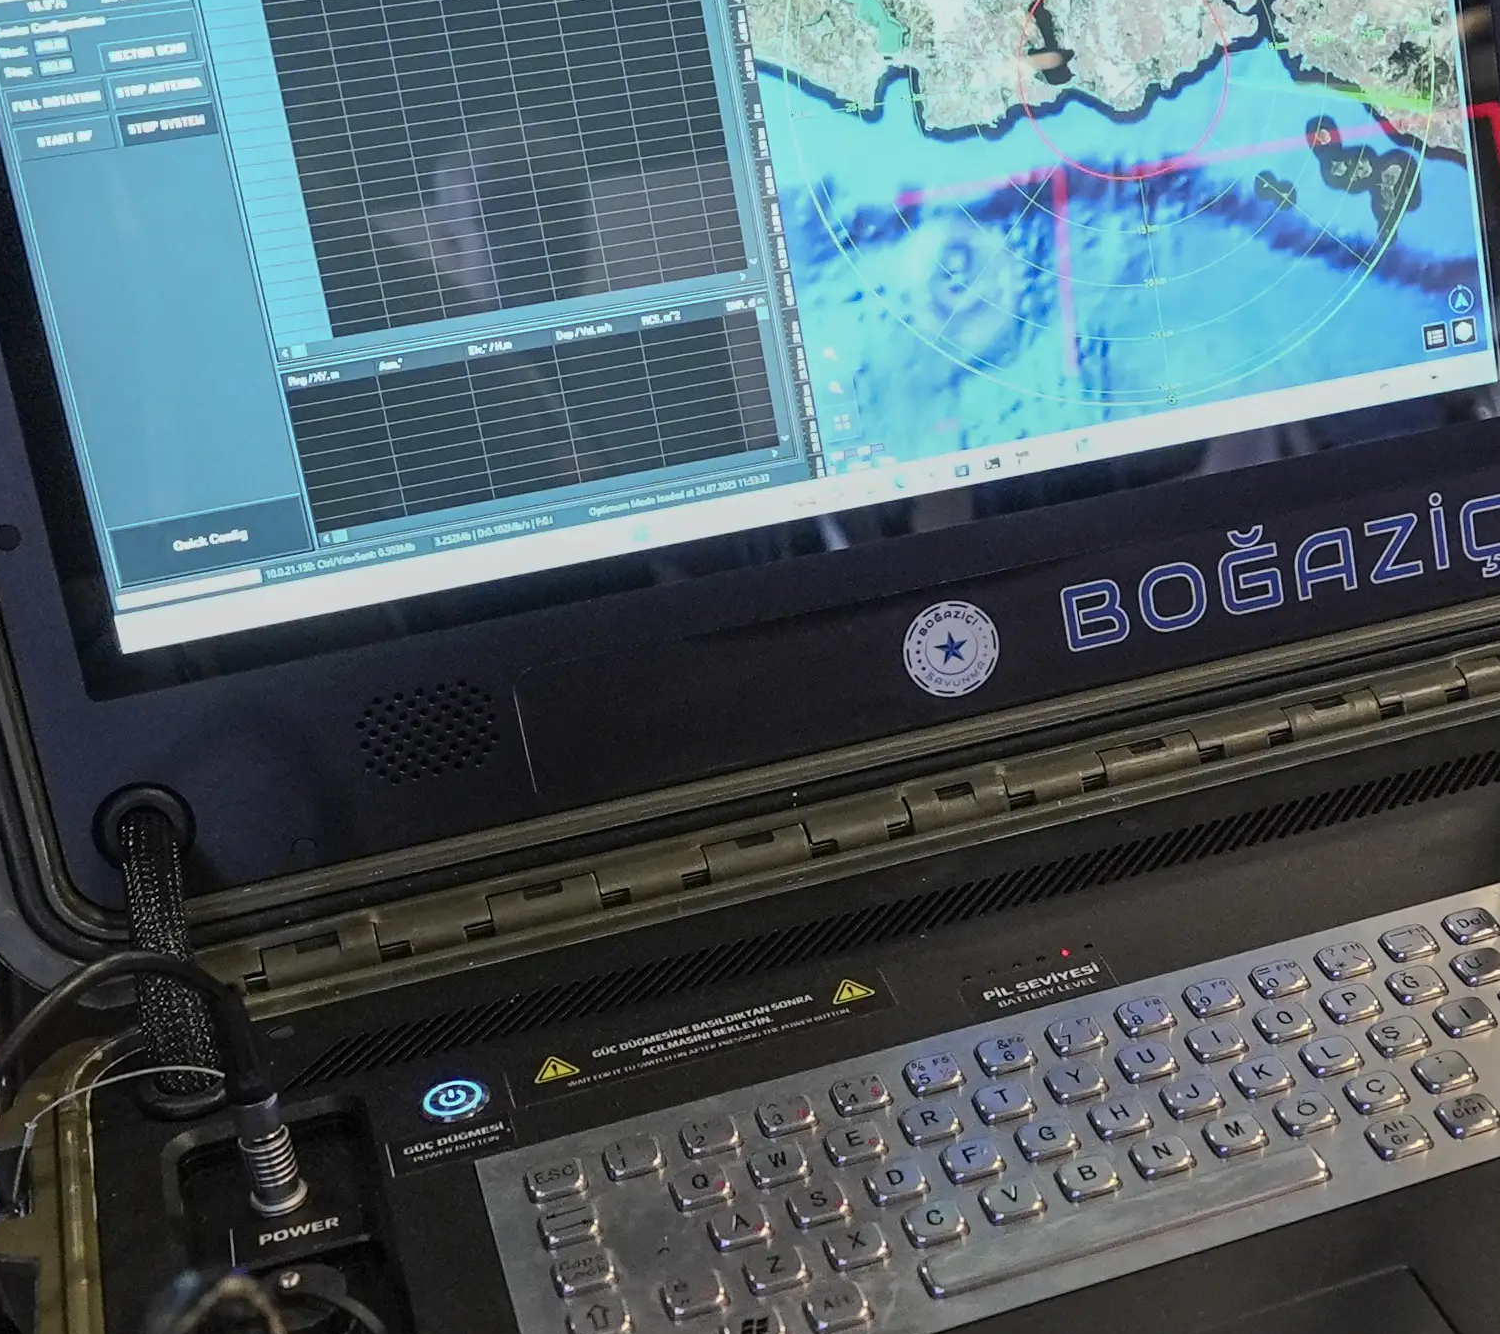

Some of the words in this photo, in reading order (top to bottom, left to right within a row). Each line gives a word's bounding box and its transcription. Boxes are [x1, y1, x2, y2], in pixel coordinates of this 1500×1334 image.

[589, 500, 630, 518] Optimum
[173, 535, 208, 552] Quick
[209, 528, 248, 545] Config
[919, 610, 979, 636] BOĞAZİÇİ
[925, 661, 985, 687] SAVUNMA
[1456, 916, 1486, 930] Del
[982, 986, 1015, 1001] PİL
[1016, 961, 1101, 992] SEVİYESİ
[998, 987, 1054, 1009] BATTERY
[1057, 977, 1098, 992] LEVEL
[1342, 991, 1357, 1008] P
[592, 1045, 618, 1059] GÜÇ
[619, 1026, 692, 1053] DÜĞMESİNE
[692, 1006, 770, 1033] BASILDIKTAN
[771, 993, 814, 1012] SONRA
[1276, 1010, 1294, 1025] O
[641, 1032, 711, 1057] AÇILMASINI
[1321, 1044, 1342, 1061] L
[1137, 1047, 1156, 1064] U
[1066, 1068, 1082, 1085] Y
[1252, 1062, 1271, 1080] K
[994, 1088, 1011, 1105] T
[1185, 1083, 1201, 1100] J
[921, 1110, 939, 1127] R
[1112, 1103, 1130, 1121] H
[1038, 1125, 1058, 1142] G
[1223, 1120, 1246, 1138] M
[403, 1140, 434, 1157] GÜÇ
[437, 1121, 504, 1147] DÜĞMESİ
[845, 1130, 865, 1147] E
[767, 1150, 788, 1168] W
[961, 1147, 978, 1164] F
[1152, 1141, 1173, 1160] N
[534, 1163, 575, 1186] ESC
[691, 1174, 710, 1190] Q
[886, 1169, 905, 1186] D
[1080, 1165, 1098, 1182] B
[810, 1191, 828, 1207] S
[1001, 1184, 1019, 1202] V
[731, 1213, 751, 1232] A
[925, 1209, 945, 1227] C
[259, 1216, 340, 1246] POWER
[847, 1230, 867, 1250] X
[767, 1254, 783, 1275] Z
